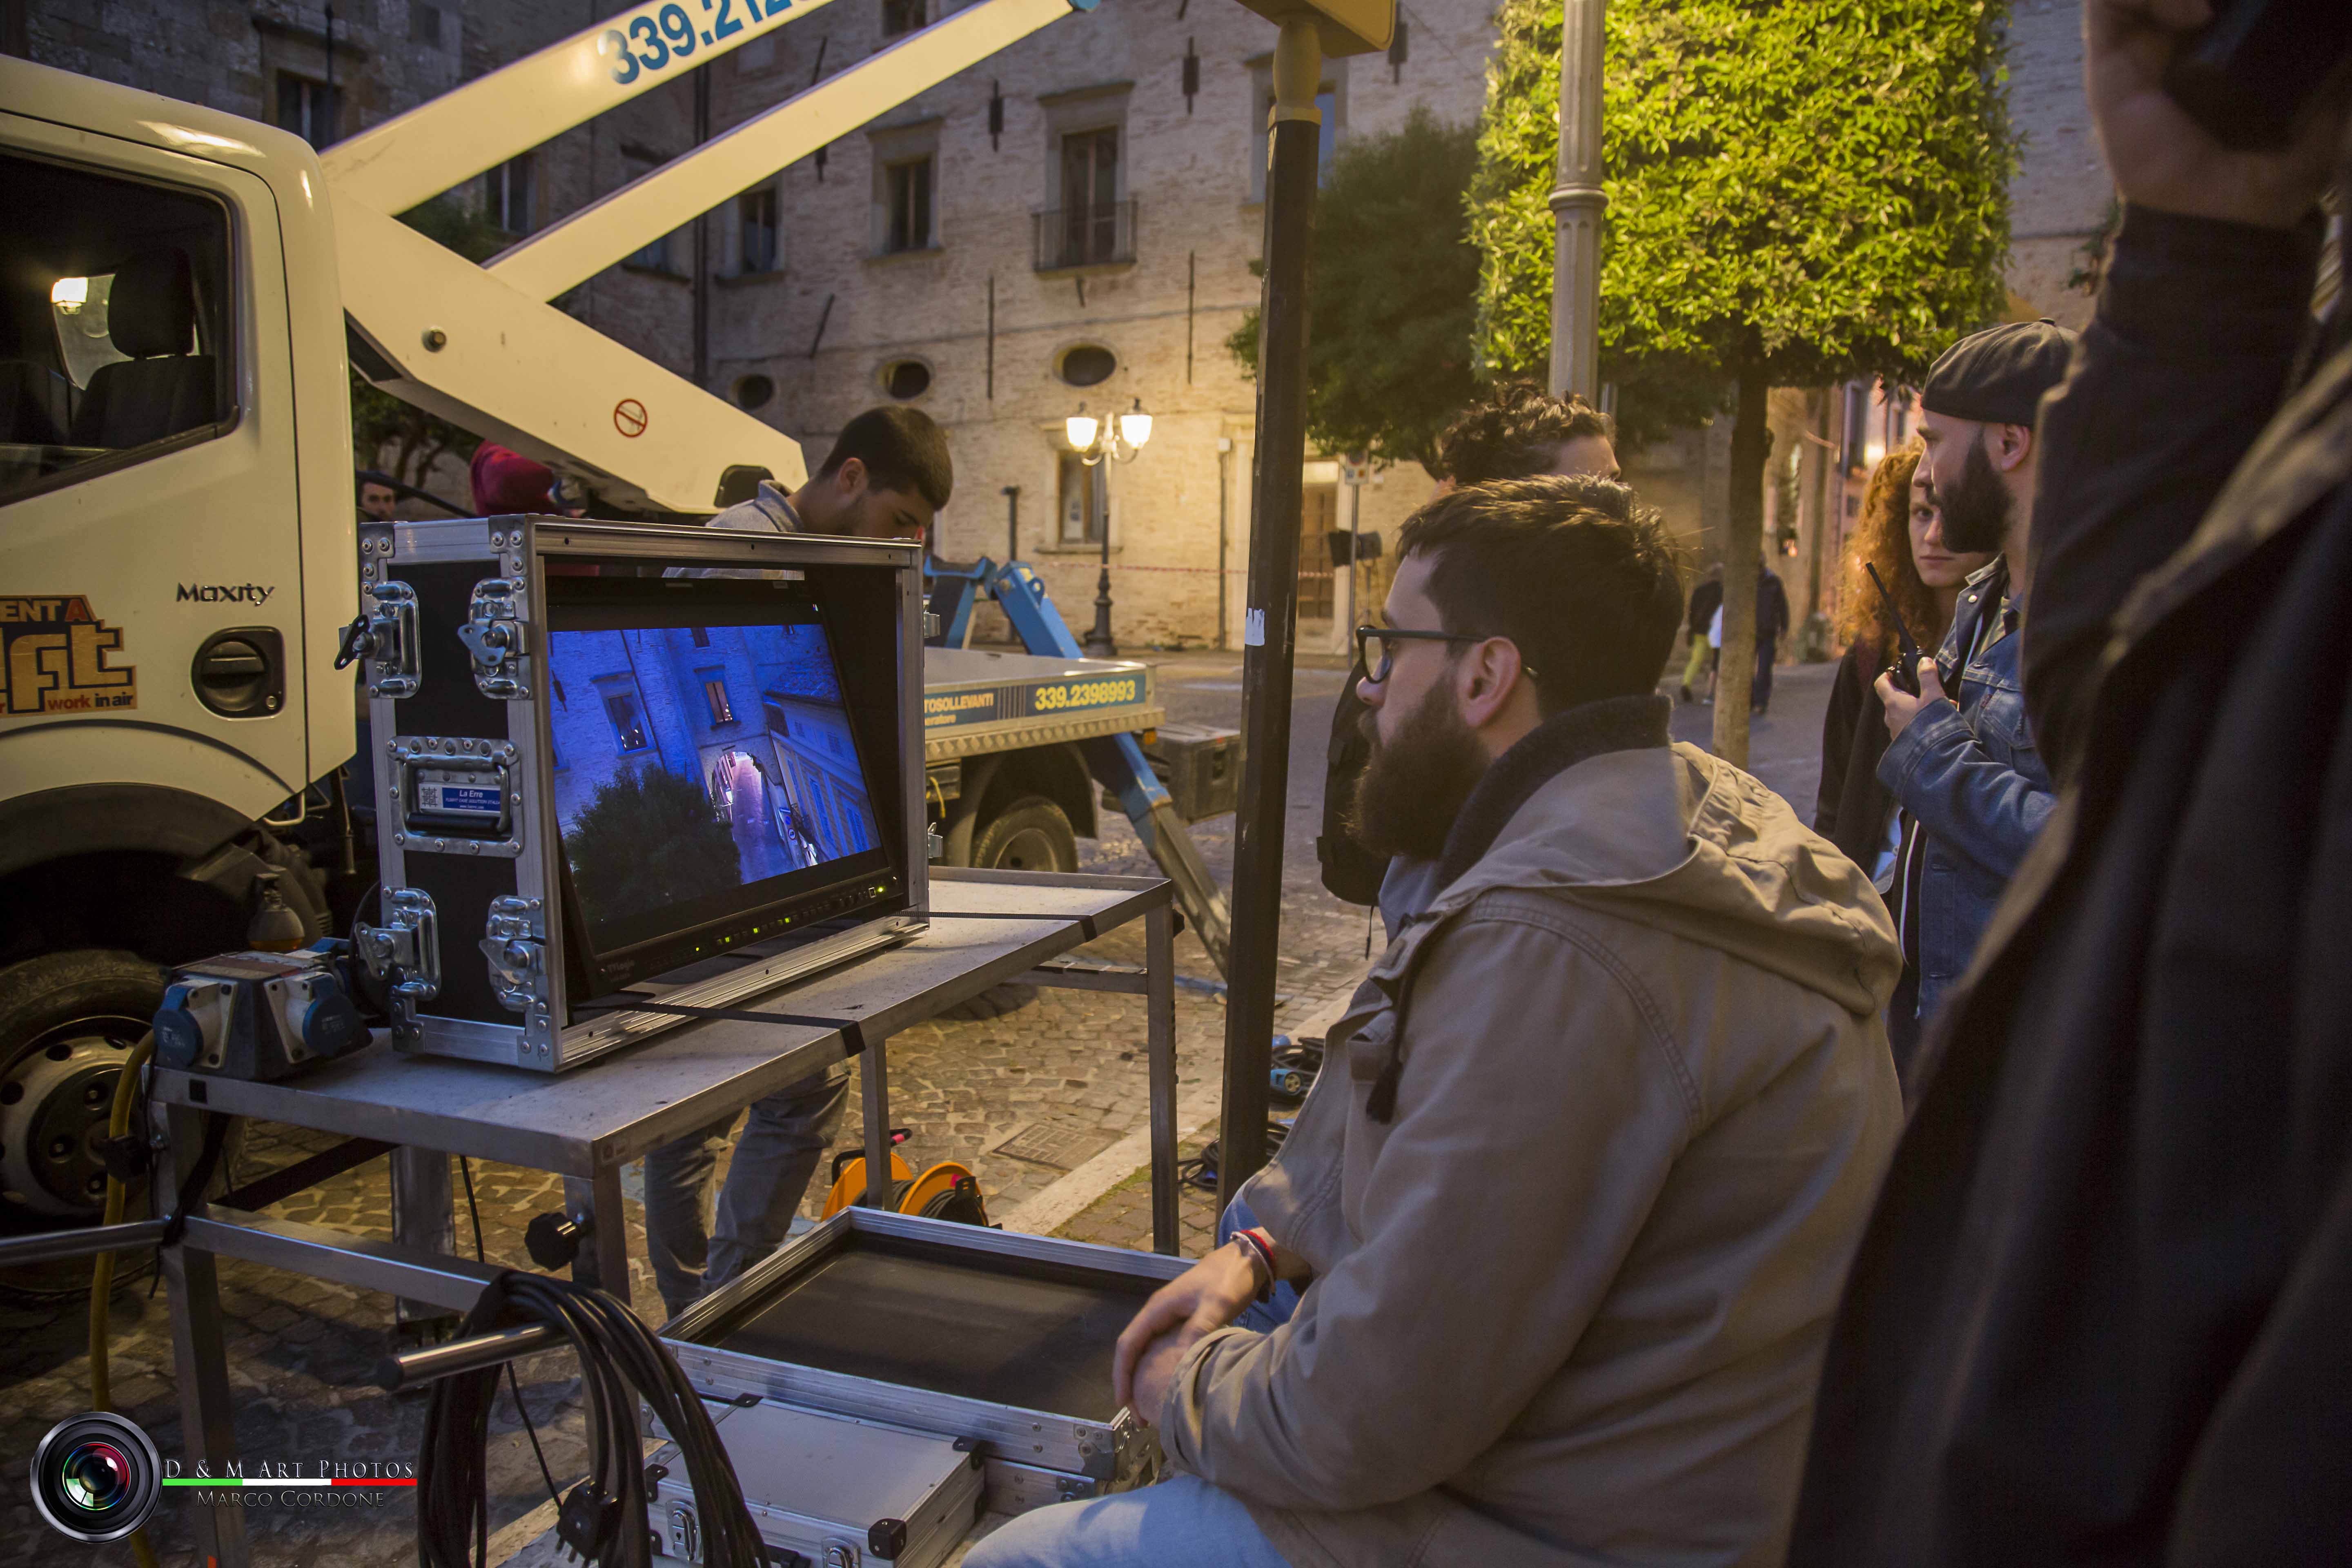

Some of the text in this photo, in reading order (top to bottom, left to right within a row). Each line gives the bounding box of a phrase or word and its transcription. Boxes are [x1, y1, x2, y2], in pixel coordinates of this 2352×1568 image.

[597, 0, 809, 85] 339.21
[176, 582, 275, 607] Maxity
[65, 599, 89, 621] A
[47, 695, 91, 710] work
[95, 693, 110, 707] in
[112, 691, 133, 706] air
[1035, 679, 1136, 710] 339.2398993
